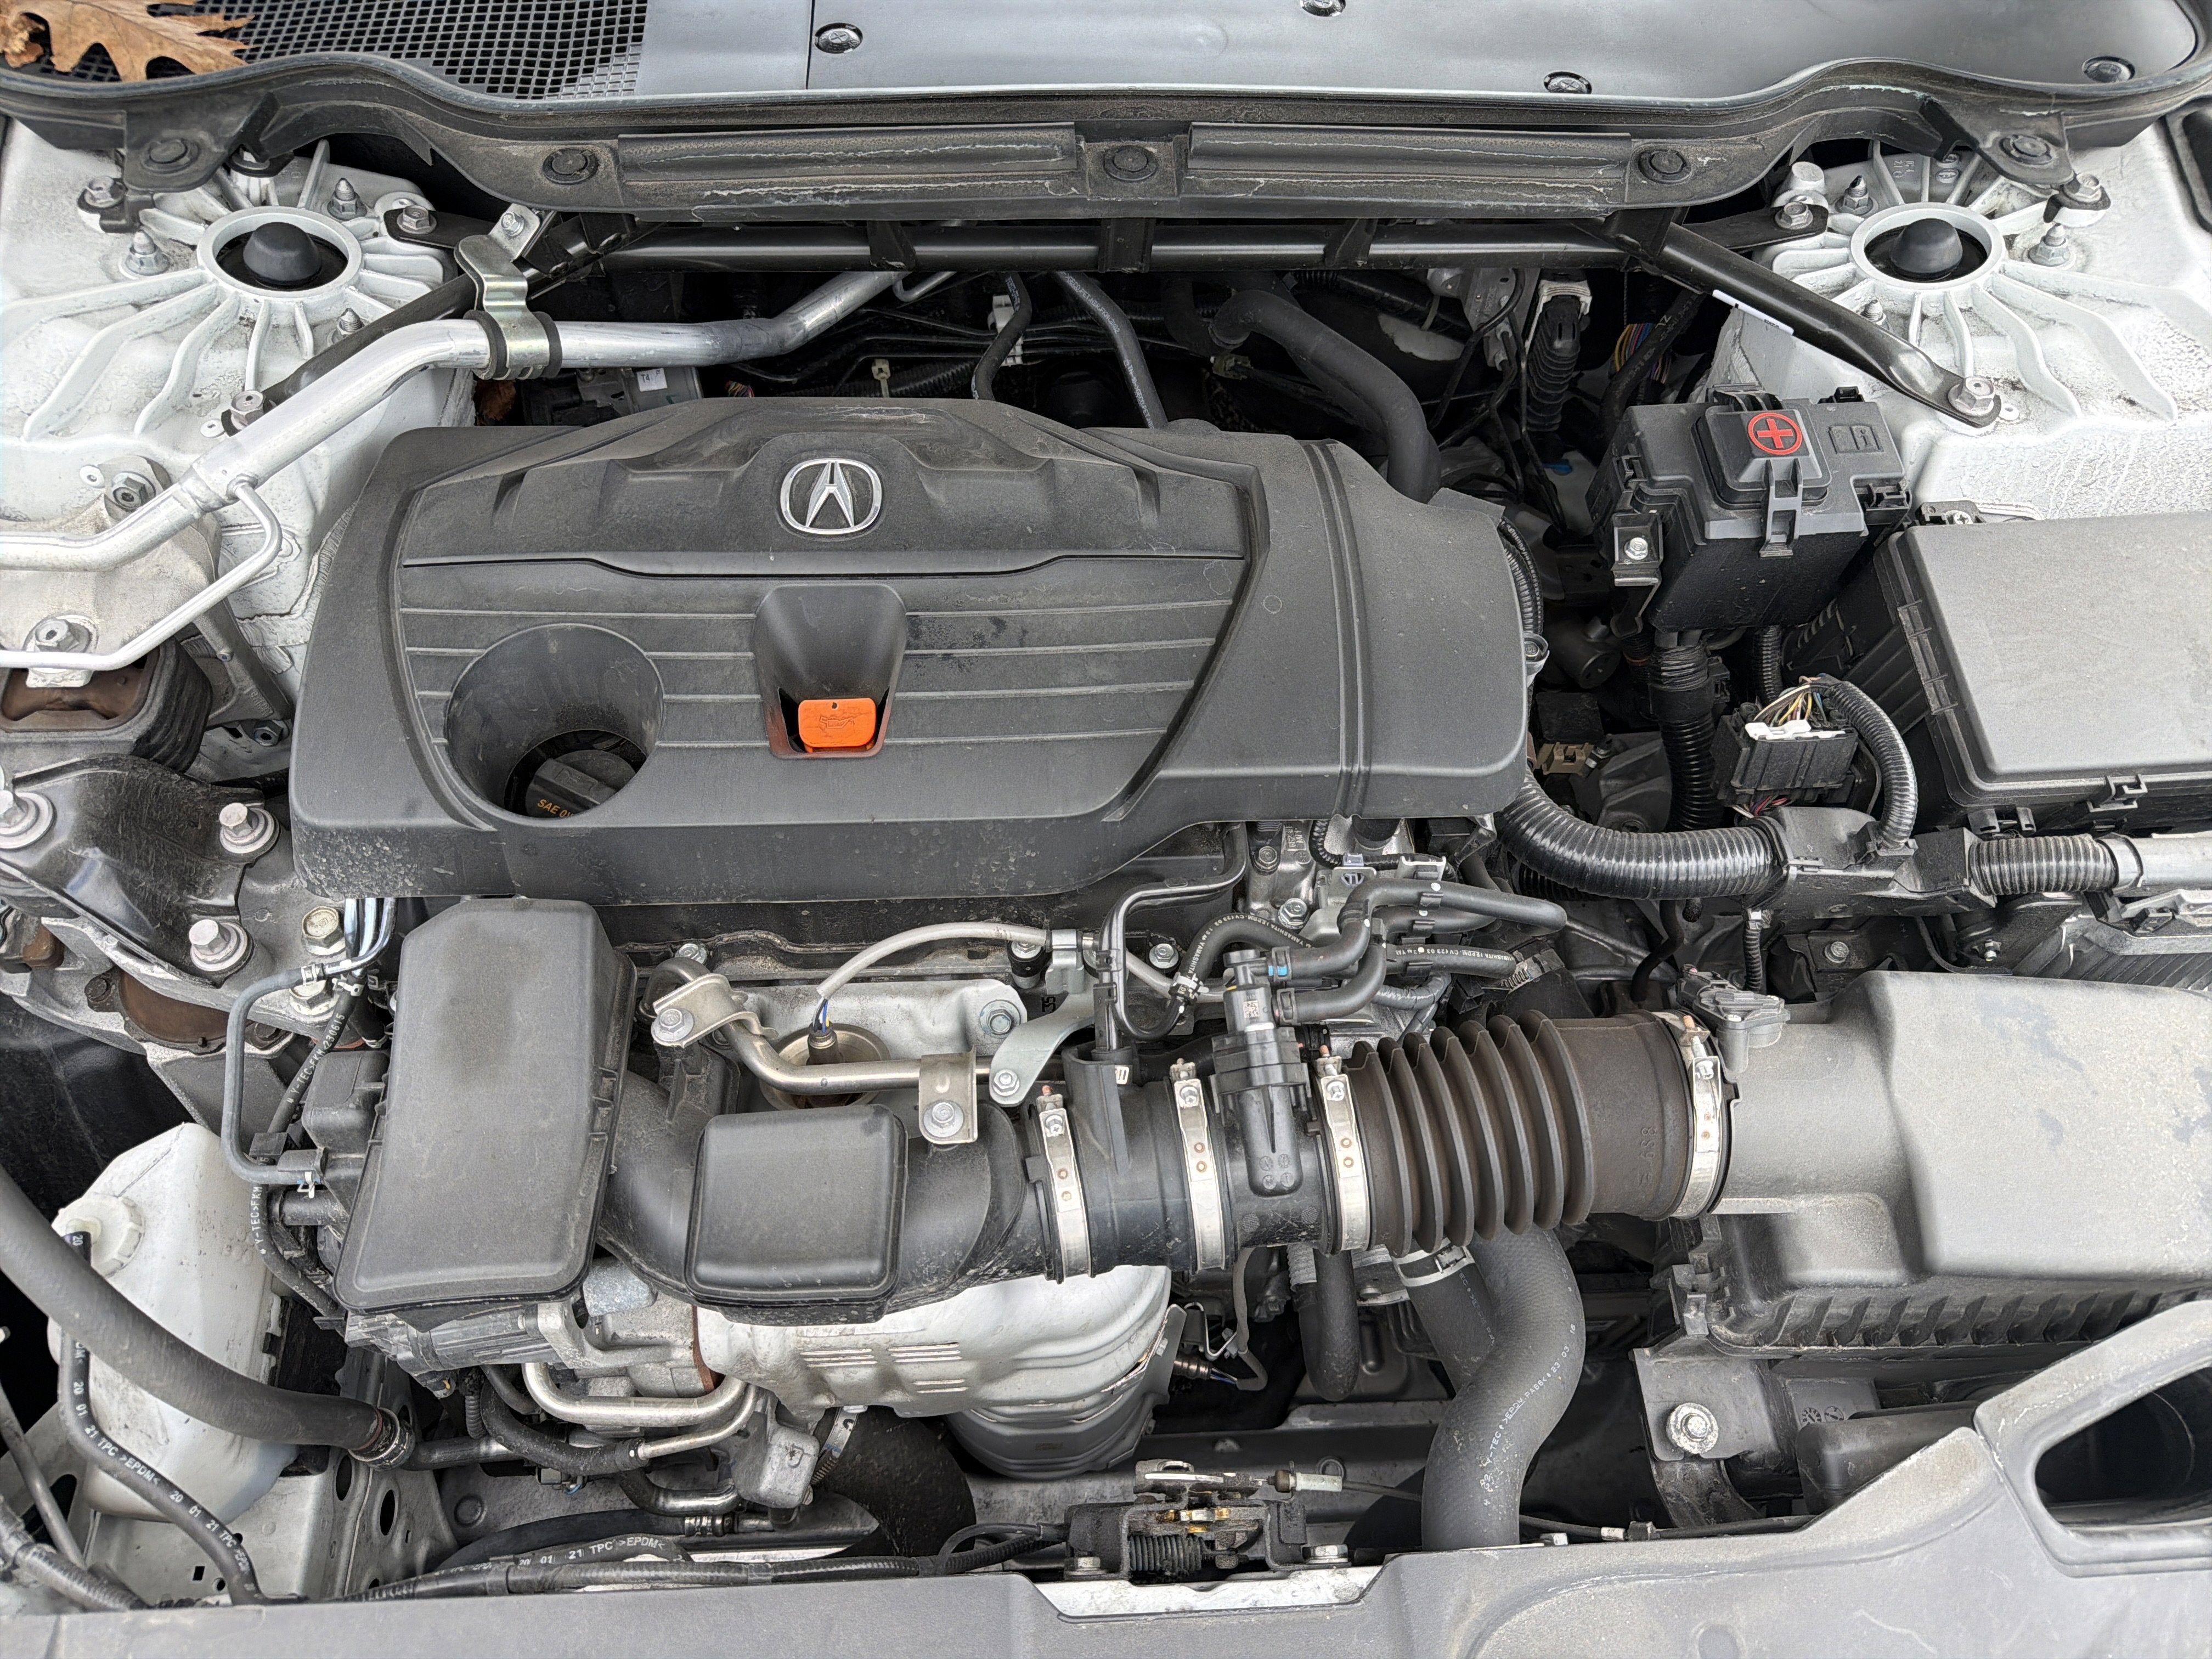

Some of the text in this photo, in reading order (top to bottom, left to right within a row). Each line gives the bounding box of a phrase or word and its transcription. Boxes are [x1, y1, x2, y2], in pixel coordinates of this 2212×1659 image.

[537, 798, 561, 814] SAE
[74, 1381, 84, 1397] 20
[76, 1403, 88, 1418] 01
[85, 1425, 99, 1440] 21
[98, 1438, 119, 1456] TPC
[170, 1490, 184, 1503] 20
[189, 1505, 202, 1518] 01
[206, 1519, 219, 1532] 21
[219, 1531, 236, 1548] TPC
[568, 1549, 584, 1560] 21
[589, 1541, 614, 1555] TPC
